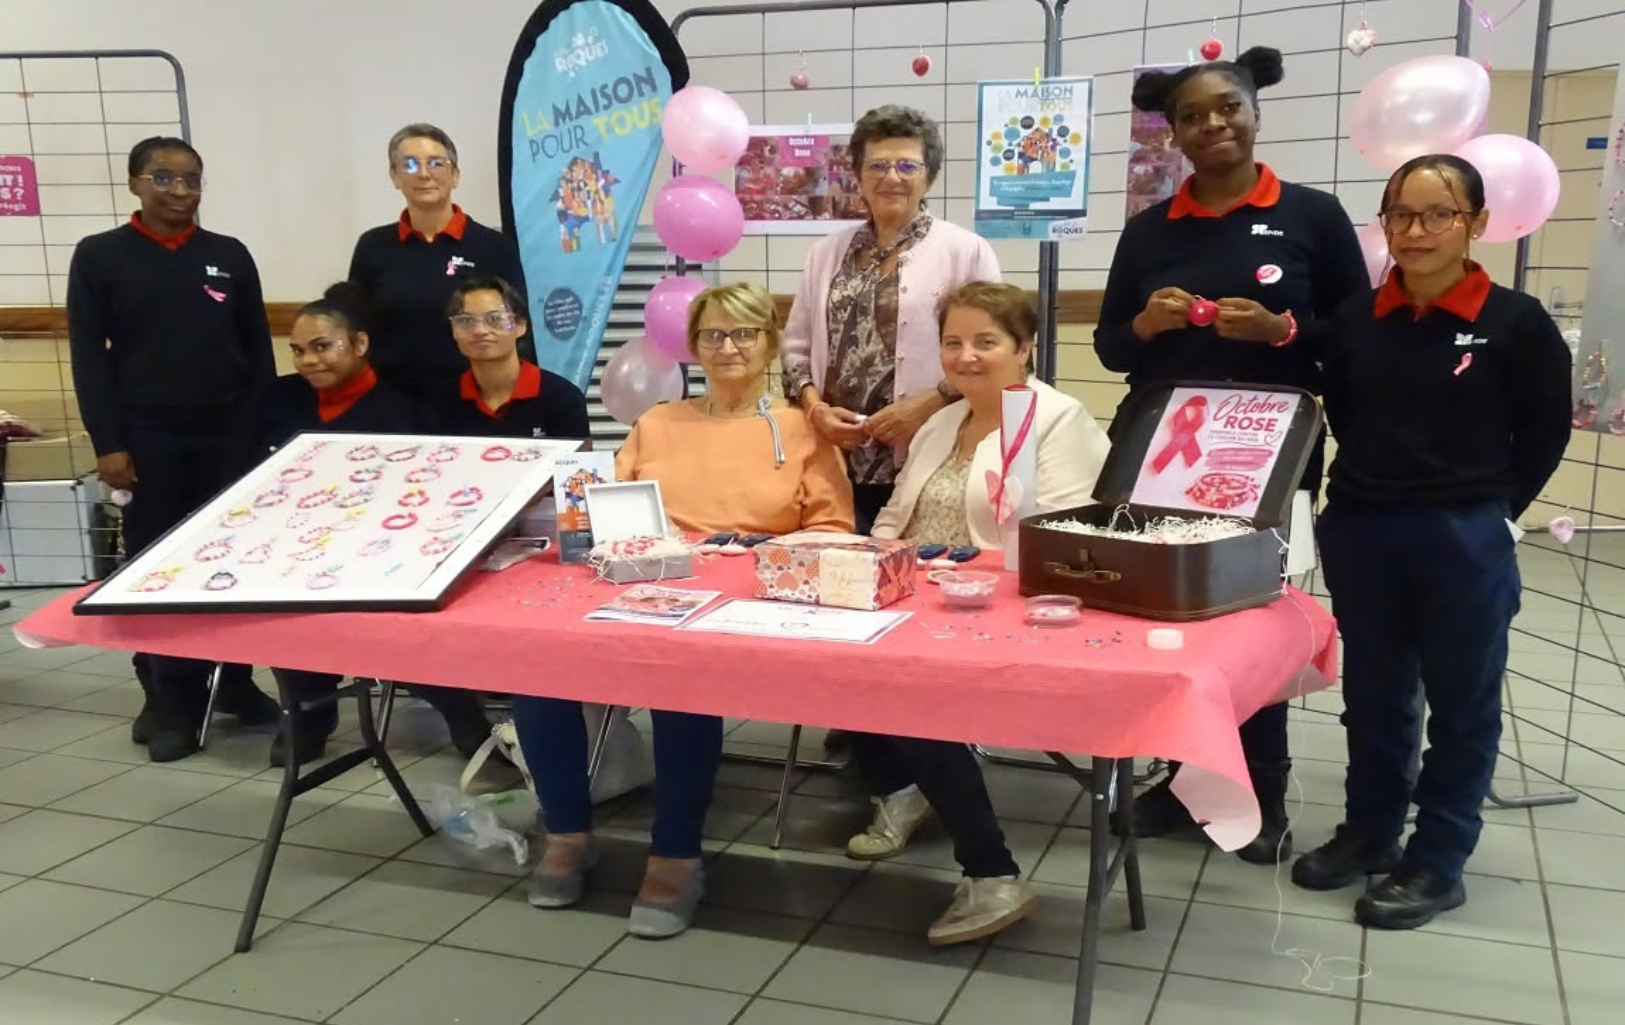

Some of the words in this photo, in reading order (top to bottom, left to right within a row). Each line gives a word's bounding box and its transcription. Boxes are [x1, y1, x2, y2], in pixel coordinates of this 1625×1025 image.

[1015, 85, 1073, 99] MAISON
[521, 109, 551, 136] LA
[552, 67, 657, 127] MAISON
[1040, 101, 1072, 112] TOUS
[529, 125, 588, 163] POUR
[593, 97, 661, 140] TOUS
[1052, 226, 1083, 234] ROQUES
[1213, 394, 1289, 421] Octobre
[1223, 415, 1279, 432] ROSE
